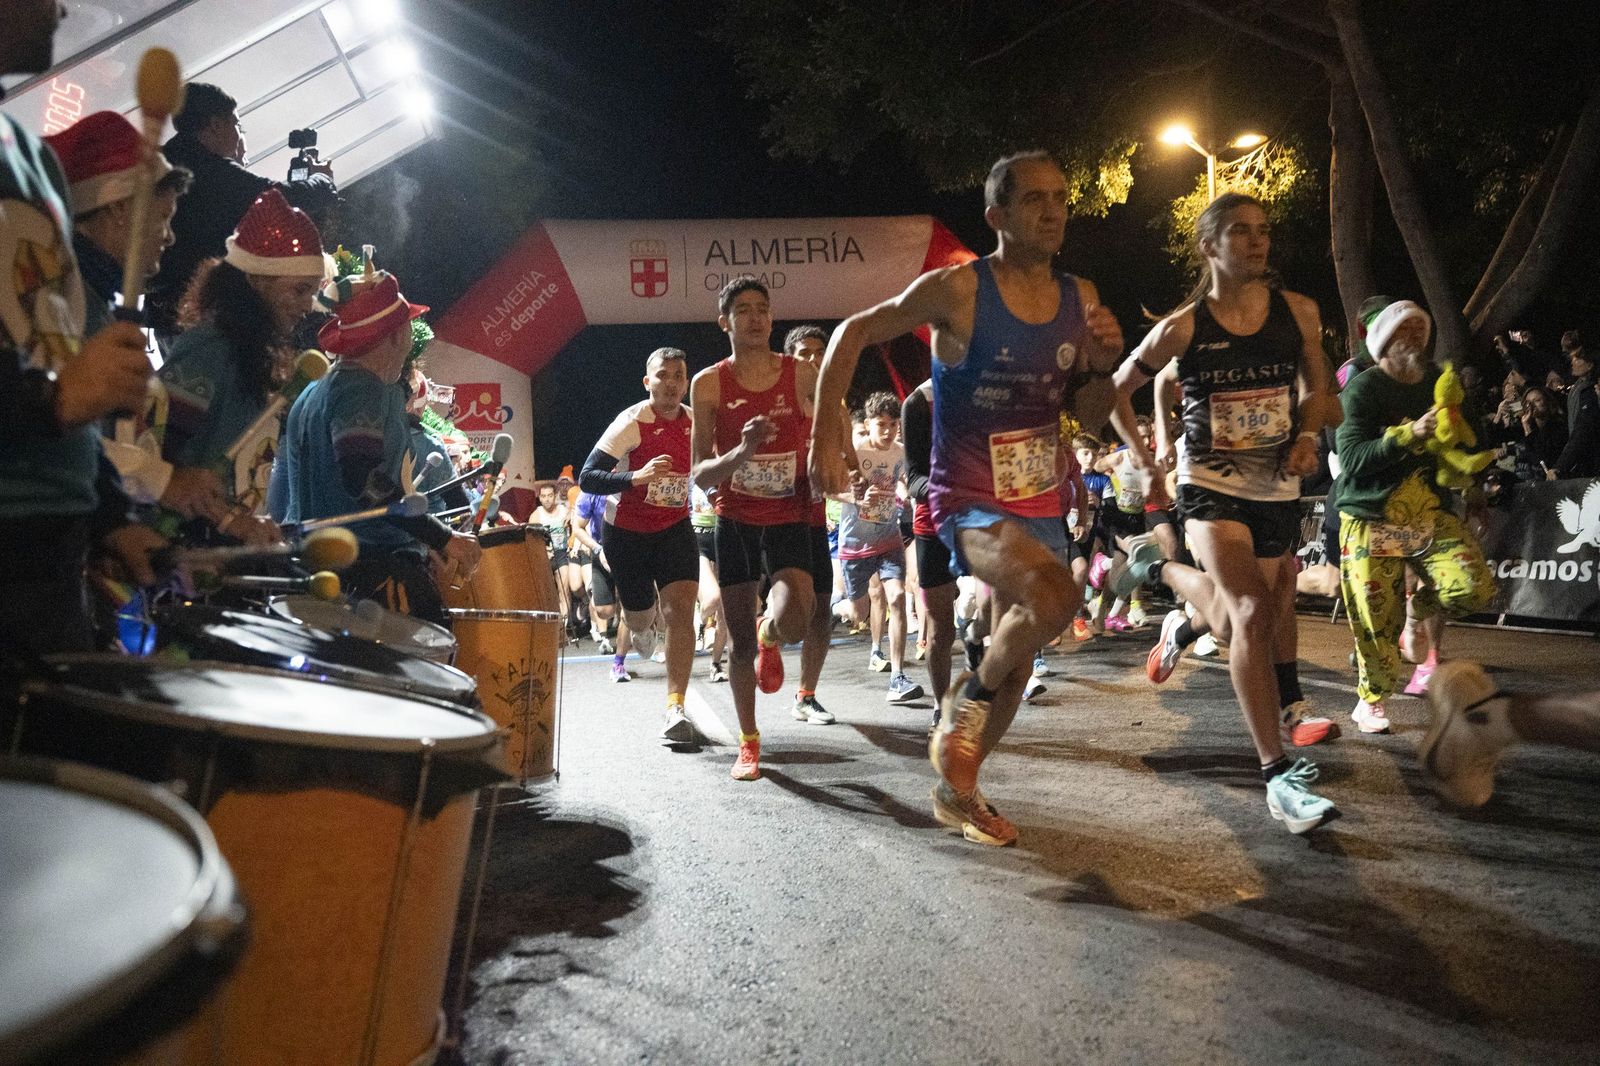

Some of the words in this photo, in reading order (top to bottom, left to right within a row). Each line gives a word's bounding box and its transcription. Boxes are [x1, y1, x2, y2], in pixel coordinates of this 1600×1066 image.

[704, 231, 865, 266] ALMERÍA
[480, 270, 546, 336] ALMERÍA
[494, 329, 513, 347] es
[510, 282, 559, 332] deporte
[1237, 413, 1269, 429] 180
[659, 485, 682, 495] 1519
